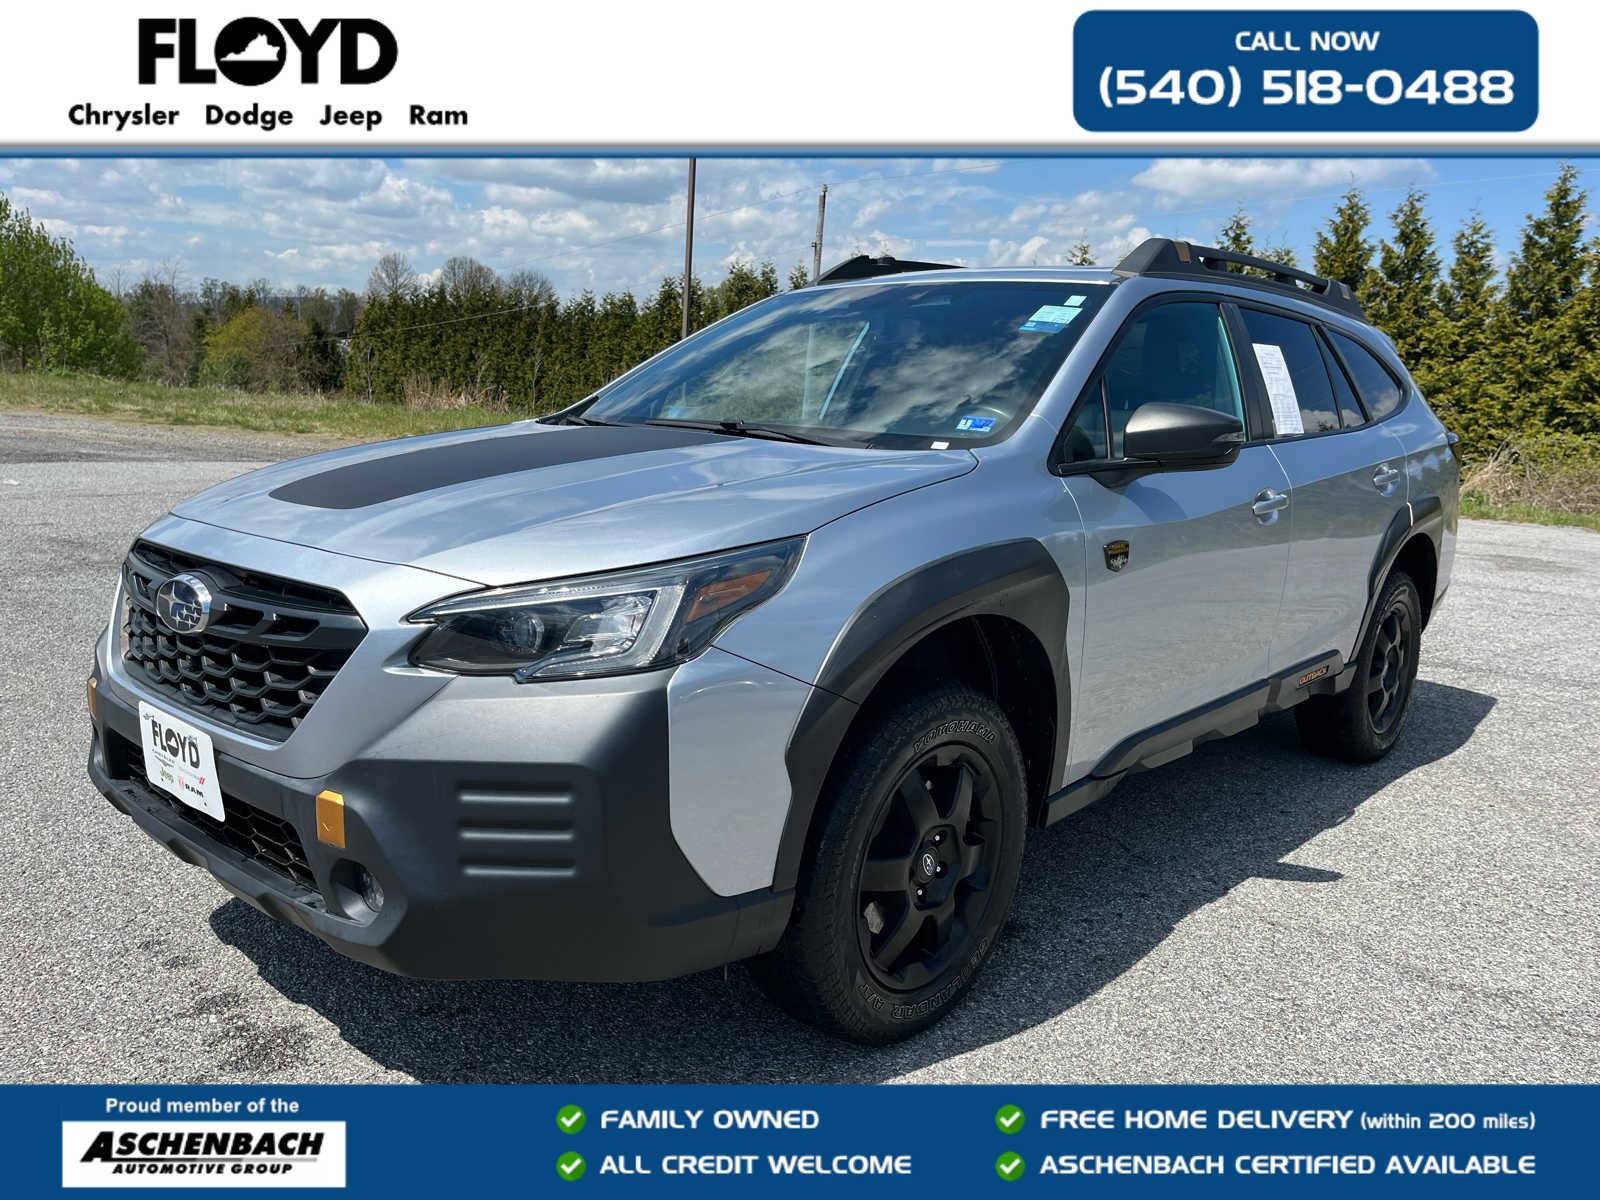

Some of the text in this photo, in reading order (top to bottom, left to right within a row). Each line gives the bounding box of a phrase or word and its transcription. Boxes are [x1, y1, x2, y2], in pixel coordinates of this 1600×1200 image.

[151, 719, 201, 769] FLOYD
[912, 719, 997, 753] YOKOHAMA
[184, 783, 205, 799] RAM
